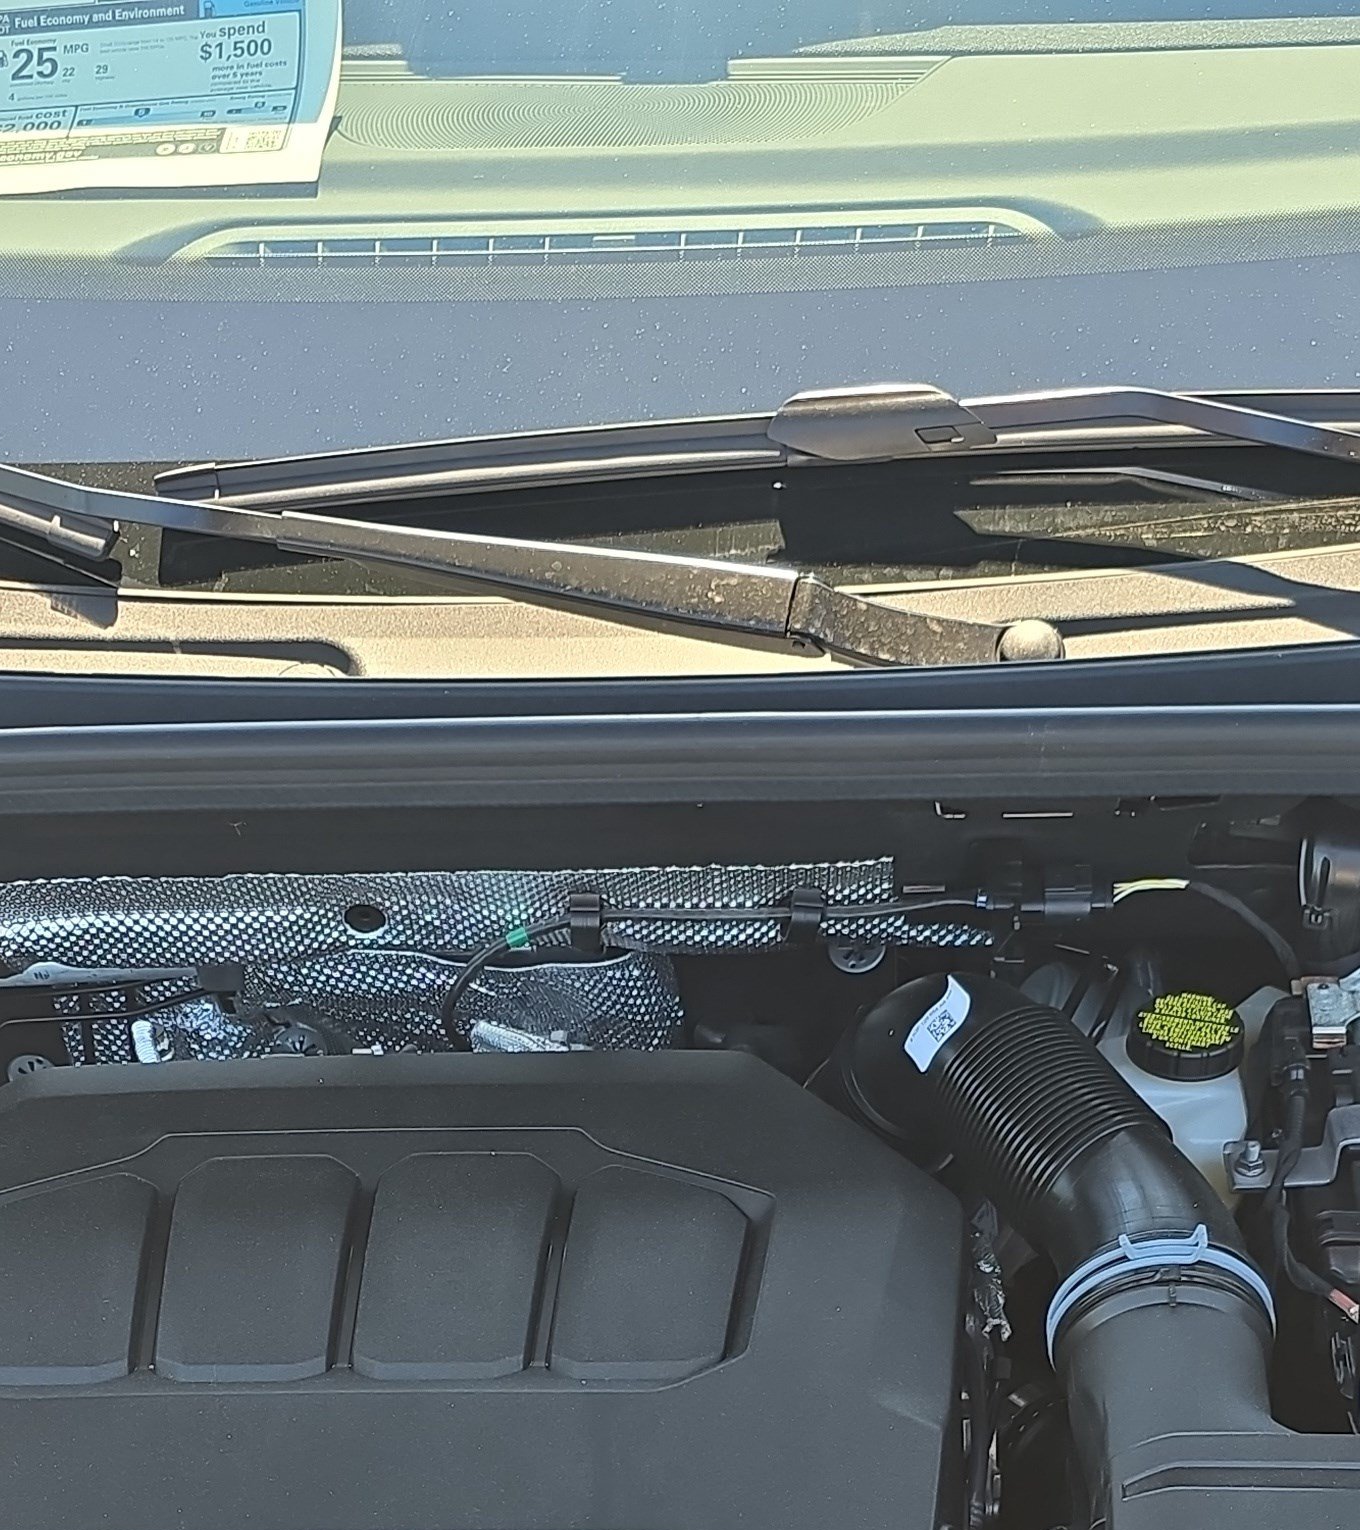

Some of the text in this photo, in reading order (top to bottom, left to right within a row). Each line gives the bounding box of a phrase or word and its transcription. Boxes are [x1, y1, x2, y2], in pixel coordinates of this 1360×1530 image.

[14, 5, 185, 29] Fuel Economy and Environment
[199, 21, 266, 40] You spend
[199, 38, 272, 62] $1,500
[11, 46, 58, 81] 25
[63, 43, 89, 55] MPG
[246, 61, 263, 69] fuel
[264, 60, 287, 68] costs
[62, 67, 75, 77] 22
[95, 65, 108, 75] 29
[240, 70, 263, 79] years
[8, 93, 15, 101] 4
[36, 109, 68, 119] cost
